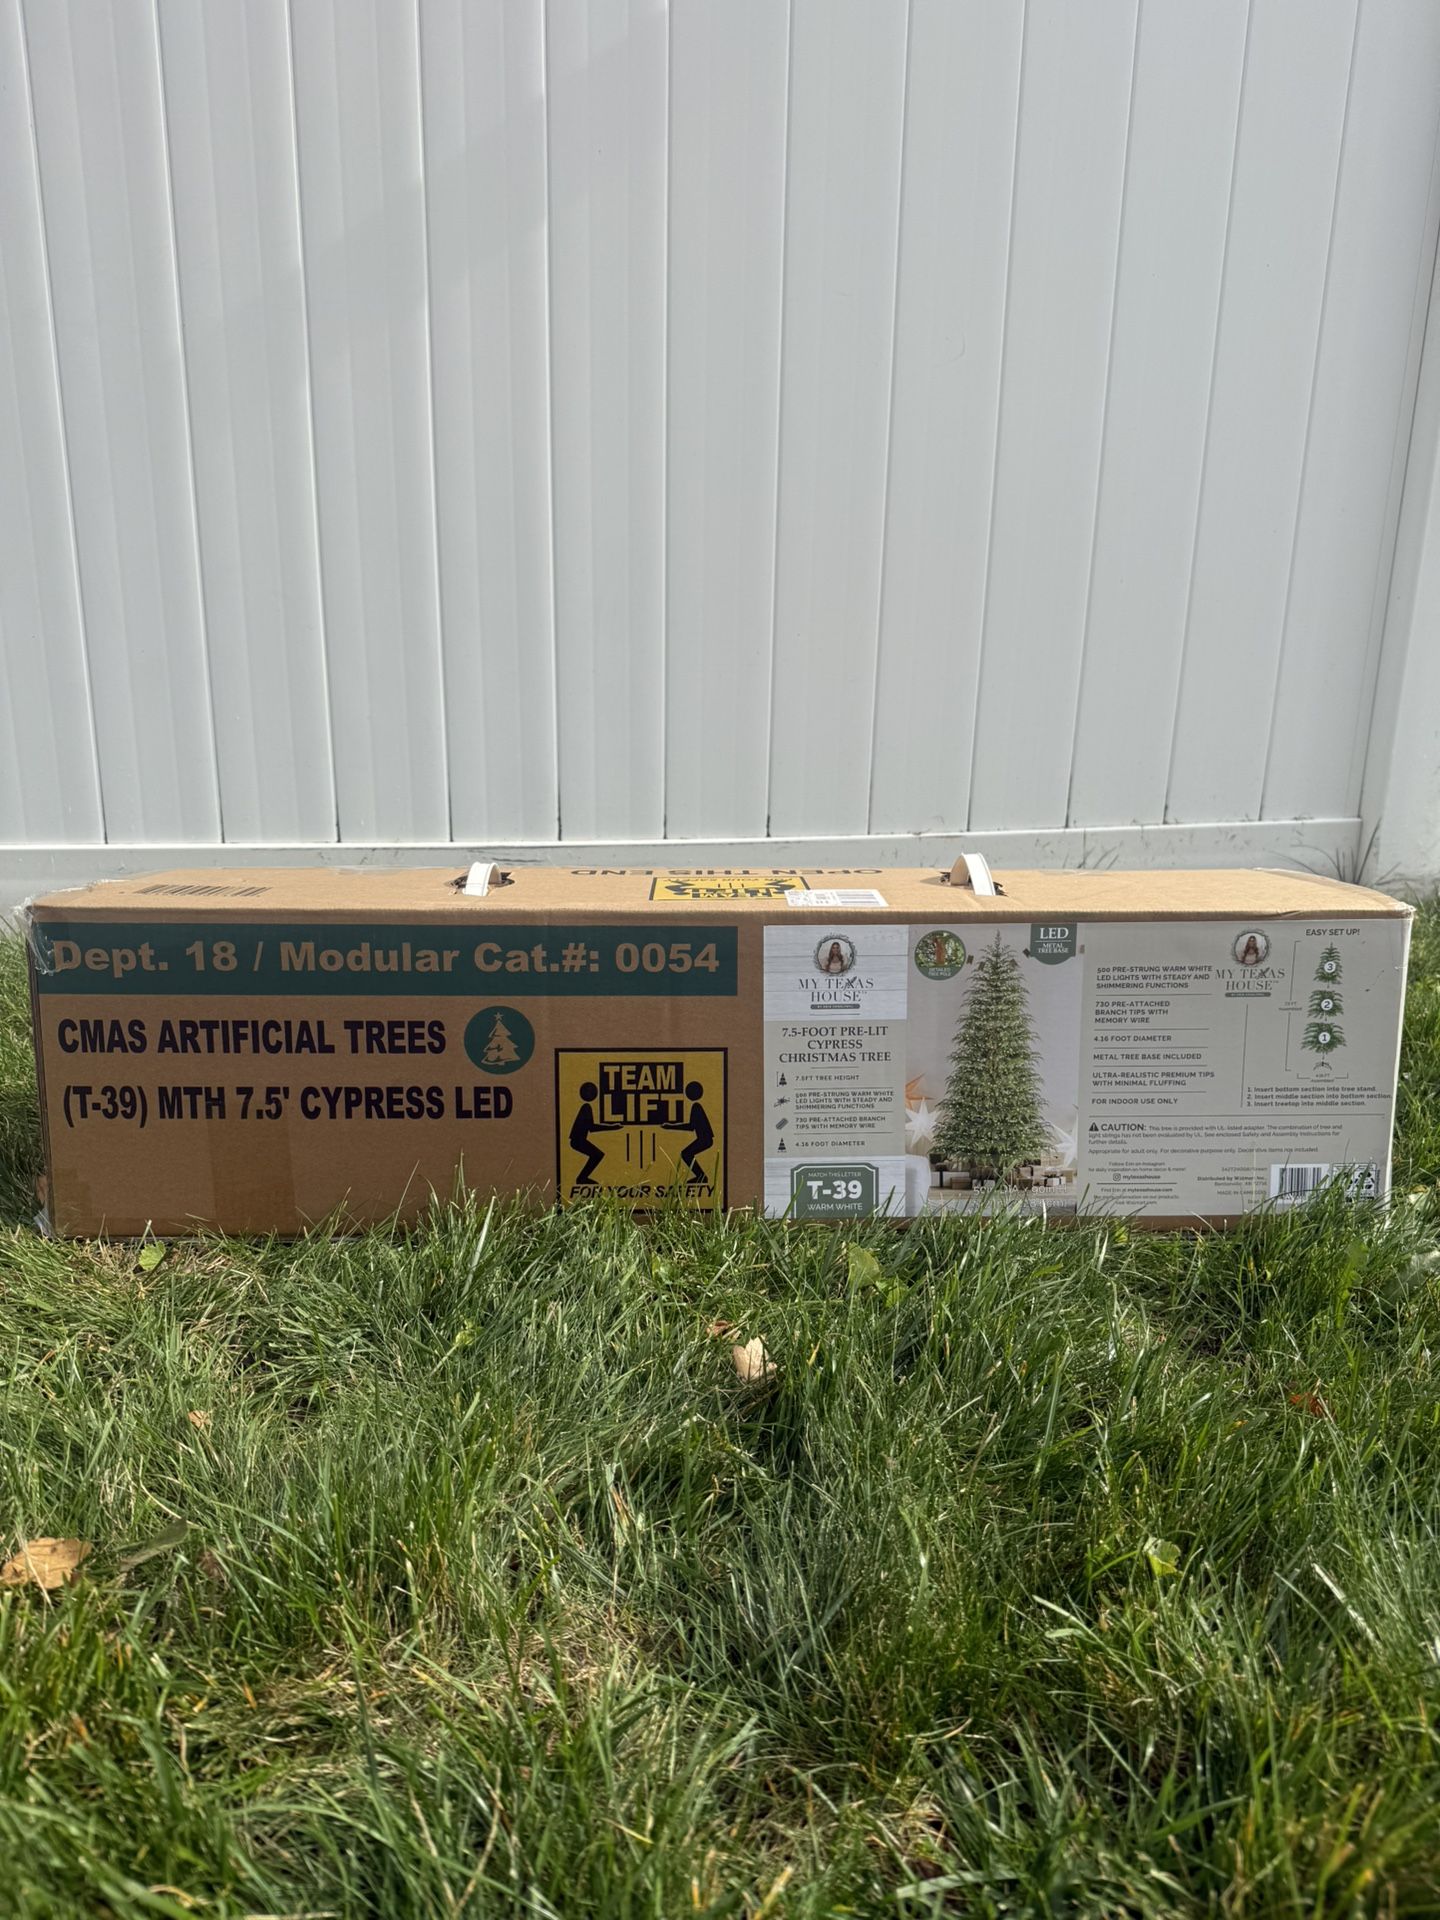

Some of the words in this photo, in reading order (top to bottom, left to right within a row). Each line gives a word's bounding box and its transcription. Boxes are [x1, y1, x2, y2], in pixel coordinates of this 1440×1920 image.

[1040, 928, 1068, 939] LED
[1305, 928, 1328, 936] EASY
[1329, 928, 1344, 936] SET
[1346, 928, 1360, 936] UP!
[53, 940, 168, 978] Dept.
[186, 940, 238, 971] 18
[253, 941, 263, 971] /
[280, 941, 460, 972] Modular
[474, 942, 599, 972] Cat.#:
[615, 942, 720, 973] 0054
[1216, 969, 1232, 979] MY
[1240, 967, 1285, 979] TEXAS
[798, 979, 817, 989] MY
[825, 976, 874, 990] TEXAS
[58, 1018, 147, 1053] CMAS
[158, 1019, 335, 1054] ARTIFICIAL
[344, 1020, 446, 1054] TREES
[782, 1027, 837, 1037] 7.5-FOOT
[841, 1026, 888, 1036] PRE-LIT
[807, 1040, 863, 1050] CYPRESS
[779, 1052, 856, 1063] CHRISTMAS
[859, 1052, 891, 1061] TREE
[604, 1065, 676, 1090] TEAM
[63, 1085, 148, 1128] (T-39)
[158, 1086, 226, 1119] MTH
[236, 1086, 290, 1120] 7.5'
[301, 1086, 445, 1120] CYPRESS
[455, 1086, 513, 1119] LED
[603, 1093, 684, 1122] LIFT
[807, 1180, 862, 1199] T-39
